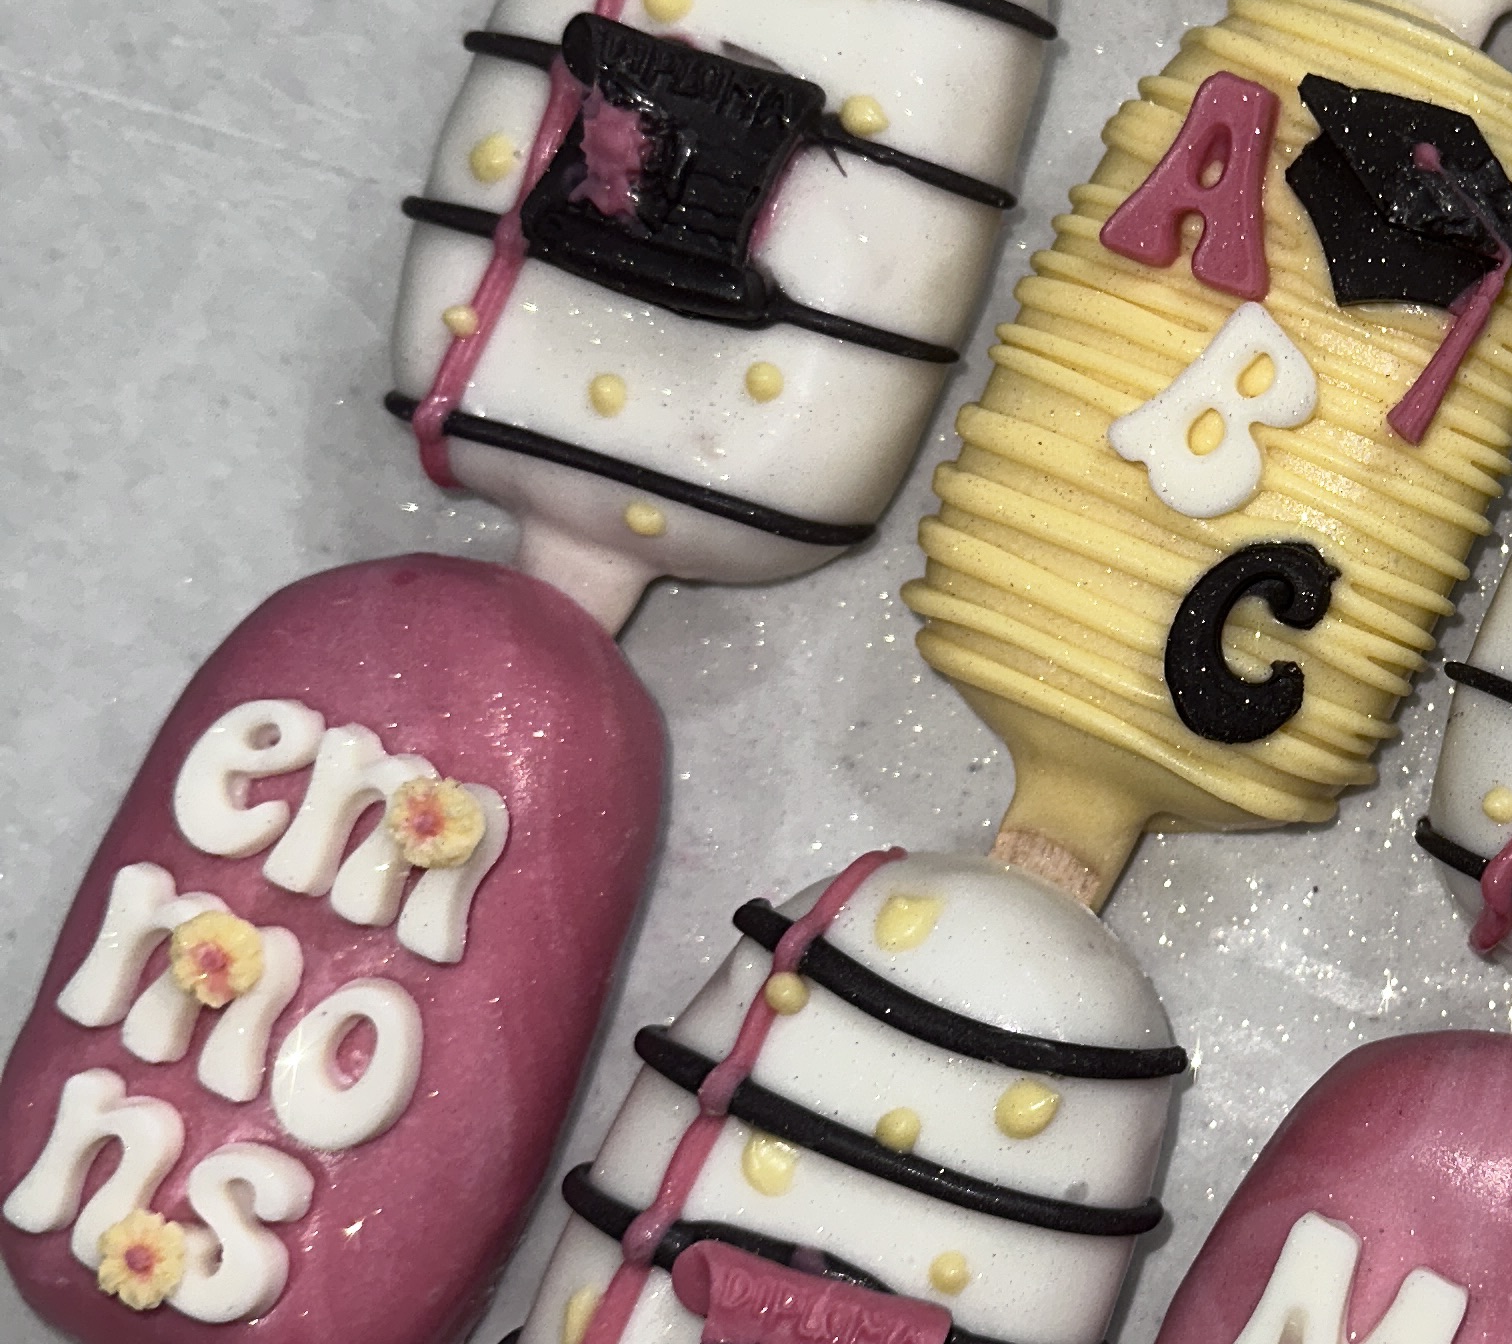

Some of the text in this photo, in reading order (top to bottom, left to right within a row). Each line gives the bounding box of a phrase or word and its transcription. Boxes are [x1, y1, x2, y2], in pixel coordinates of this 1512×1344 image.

[1100, 70, 1280, 302] A
[1107, 302, 1319, 518] B
[1165, 542, 1341, 744] C
[173, 699, 509, 963] em
[57, 862, 423, 1150] mo
[3, 1068, 315, 1323] ns
